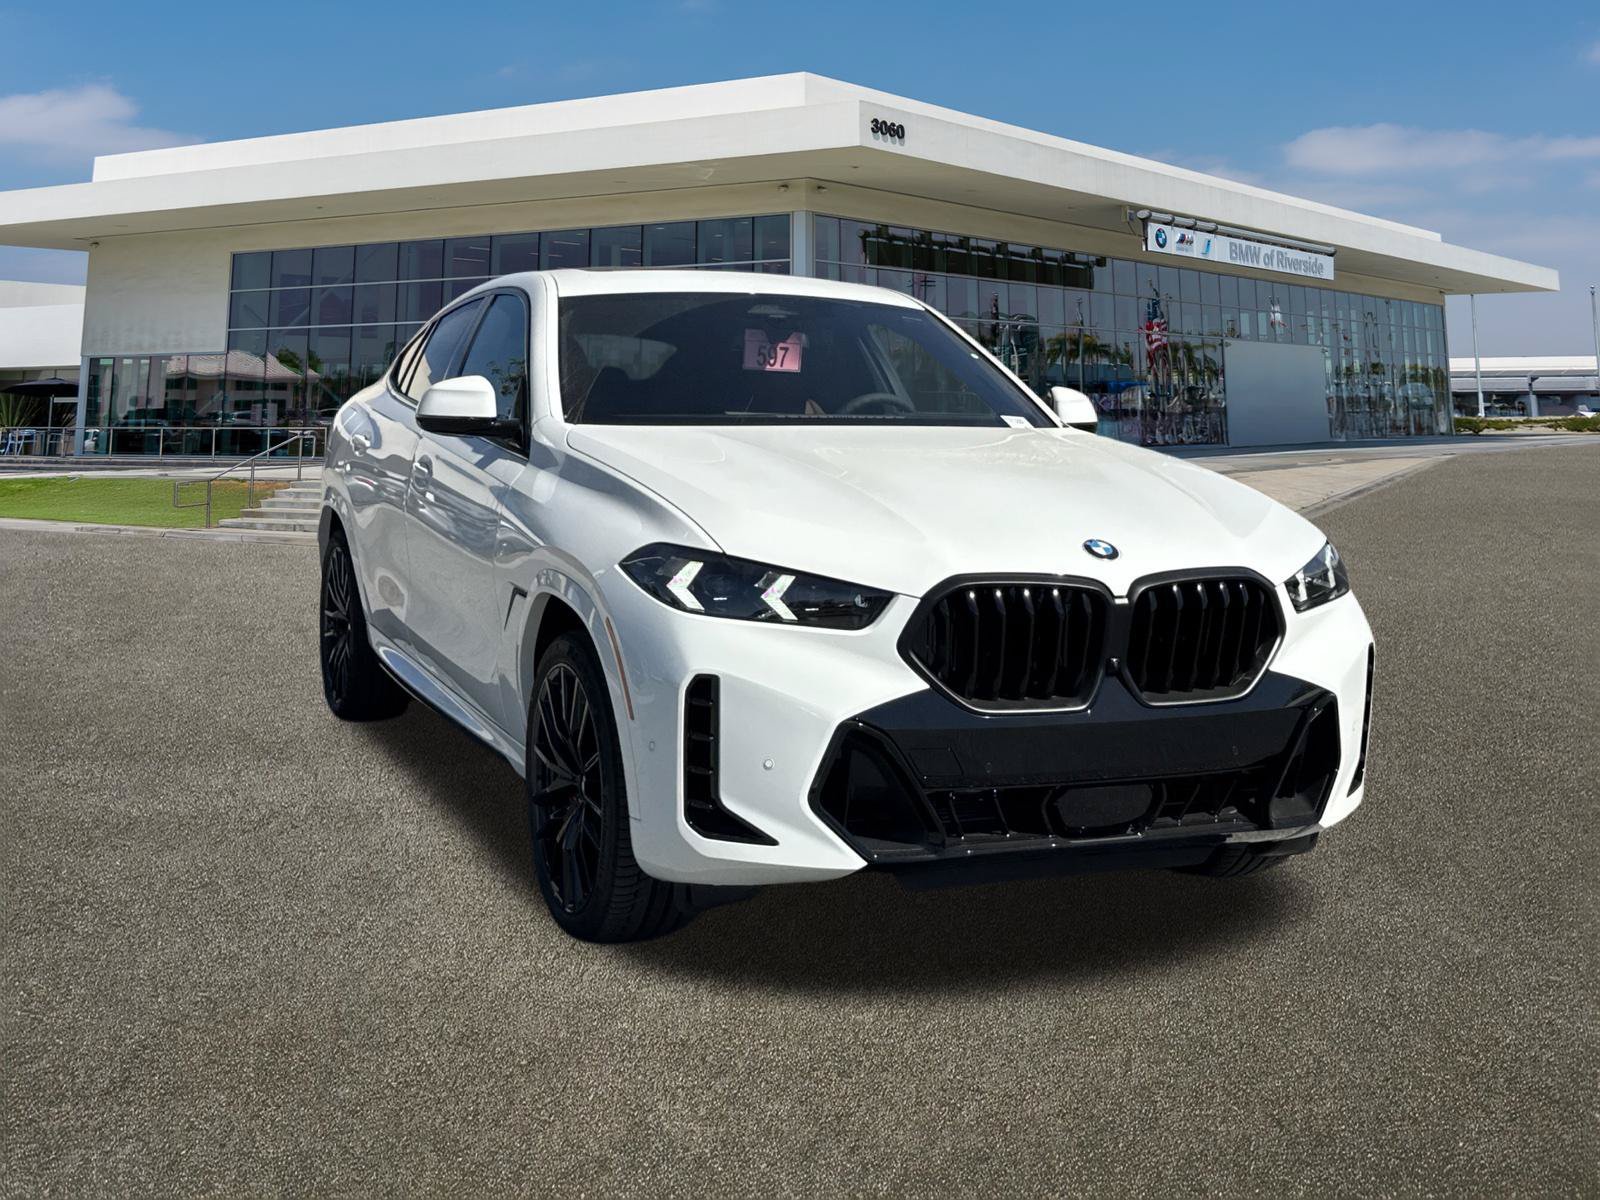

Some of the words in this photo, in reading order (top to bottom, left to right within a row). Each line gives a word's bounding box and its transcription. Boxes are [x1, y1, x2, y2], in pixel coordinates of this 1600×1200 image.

[870, 118, 905, 139] 3060
[1229, 241, 1261, 265] BMW
[1263, 249, 1275, 268] of
[1276, 250, 1324, 274] Riverside
[756, 345, 790, 368] 597
